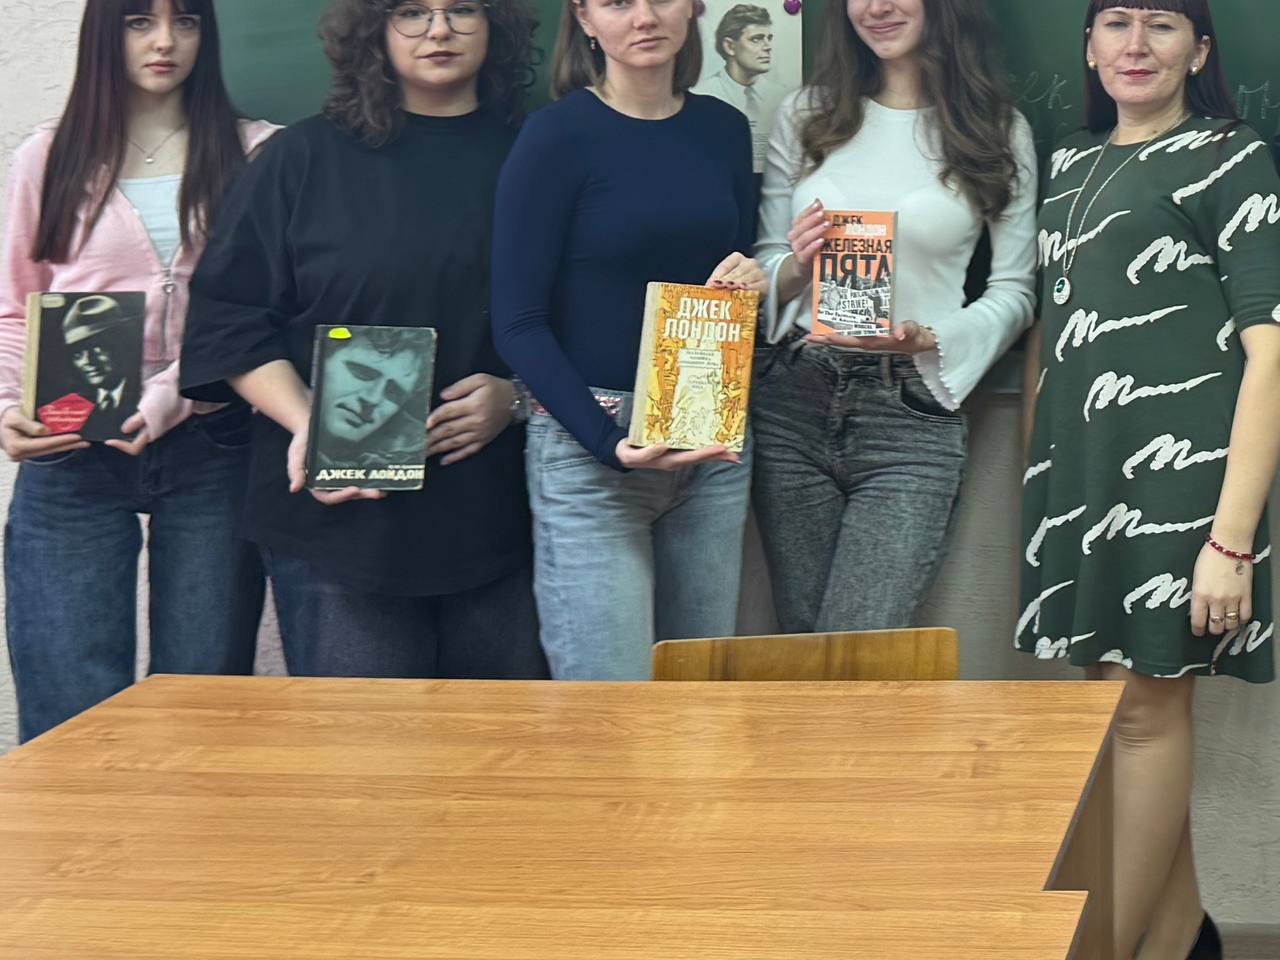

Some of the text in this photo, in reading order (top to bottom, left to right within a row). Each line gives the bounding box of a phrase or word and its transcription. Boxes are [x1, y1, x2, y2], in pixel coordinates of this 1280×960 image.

[831, 214, 864, 227] ДЖЕК
[820, 238, 893, 253] ЖЕЛЕЗНАЯ
[819, 253, 891, 290] ПЯТА
[676, 297, 732, 320] ДЖЕК
[663, 318, 741, 343] ЛОНДОН
[315, 469, 425, 481] ДЖЕК ЛОНДОН
